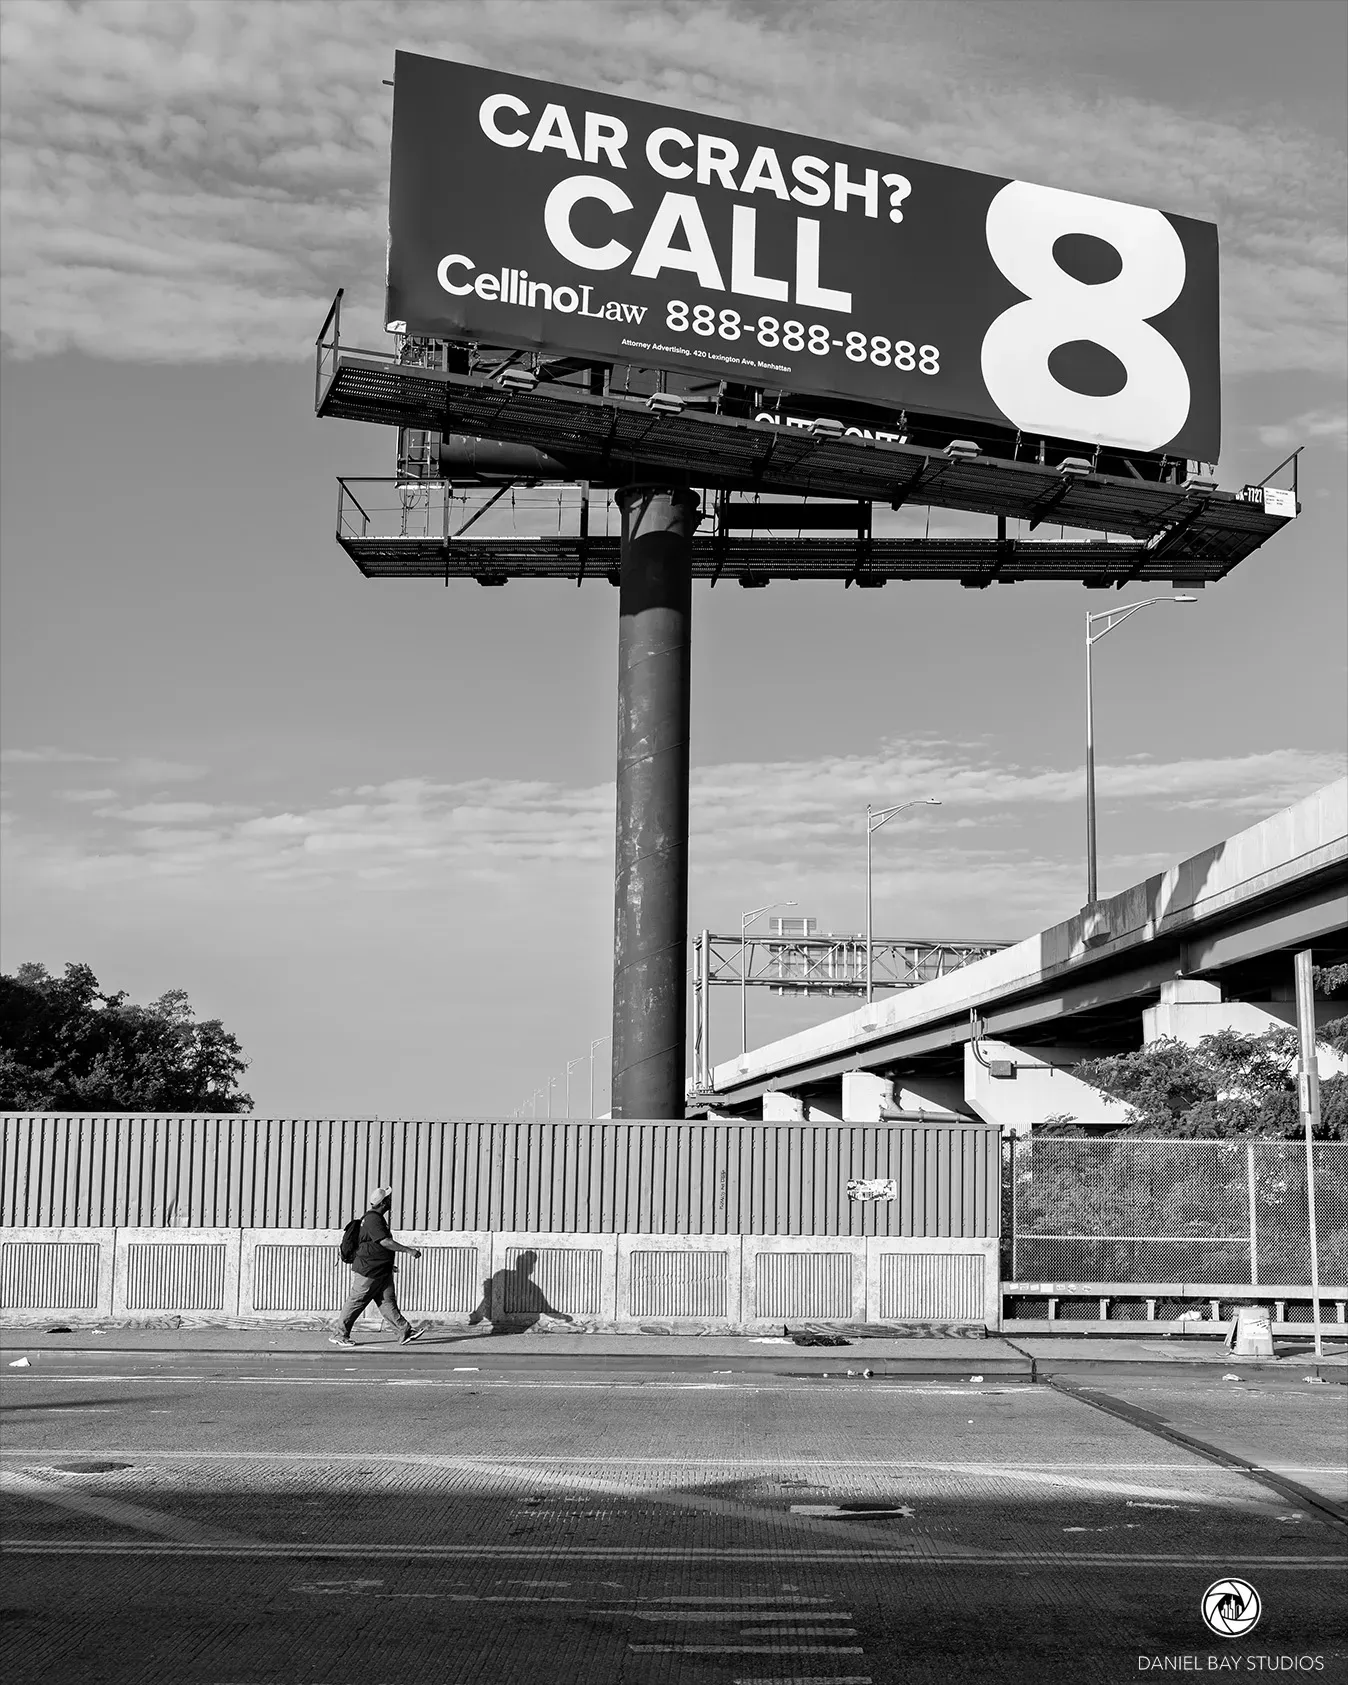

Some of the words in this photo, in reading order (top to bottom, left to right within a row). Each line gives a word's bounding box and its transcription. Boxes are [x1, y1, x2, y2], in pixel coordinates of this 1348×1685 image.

[478, 93, 629, 170] CAR
[645, 126, 912, 224] CRASH?
[543, 174, 853, 314] CALL
[622, 339, 651, 349] Attorney
[653, 343, 691, 355] Advertising.
[693, 349, 707, 358] 420
[708, 352, 740, 363] Lexington
[741, 358, 757, 367] Ave,
[758, 361, 792, 372] Manhattan
[665, 299, 940, 376] 888-888-8888
[981, 179, 1191, 452] 8
